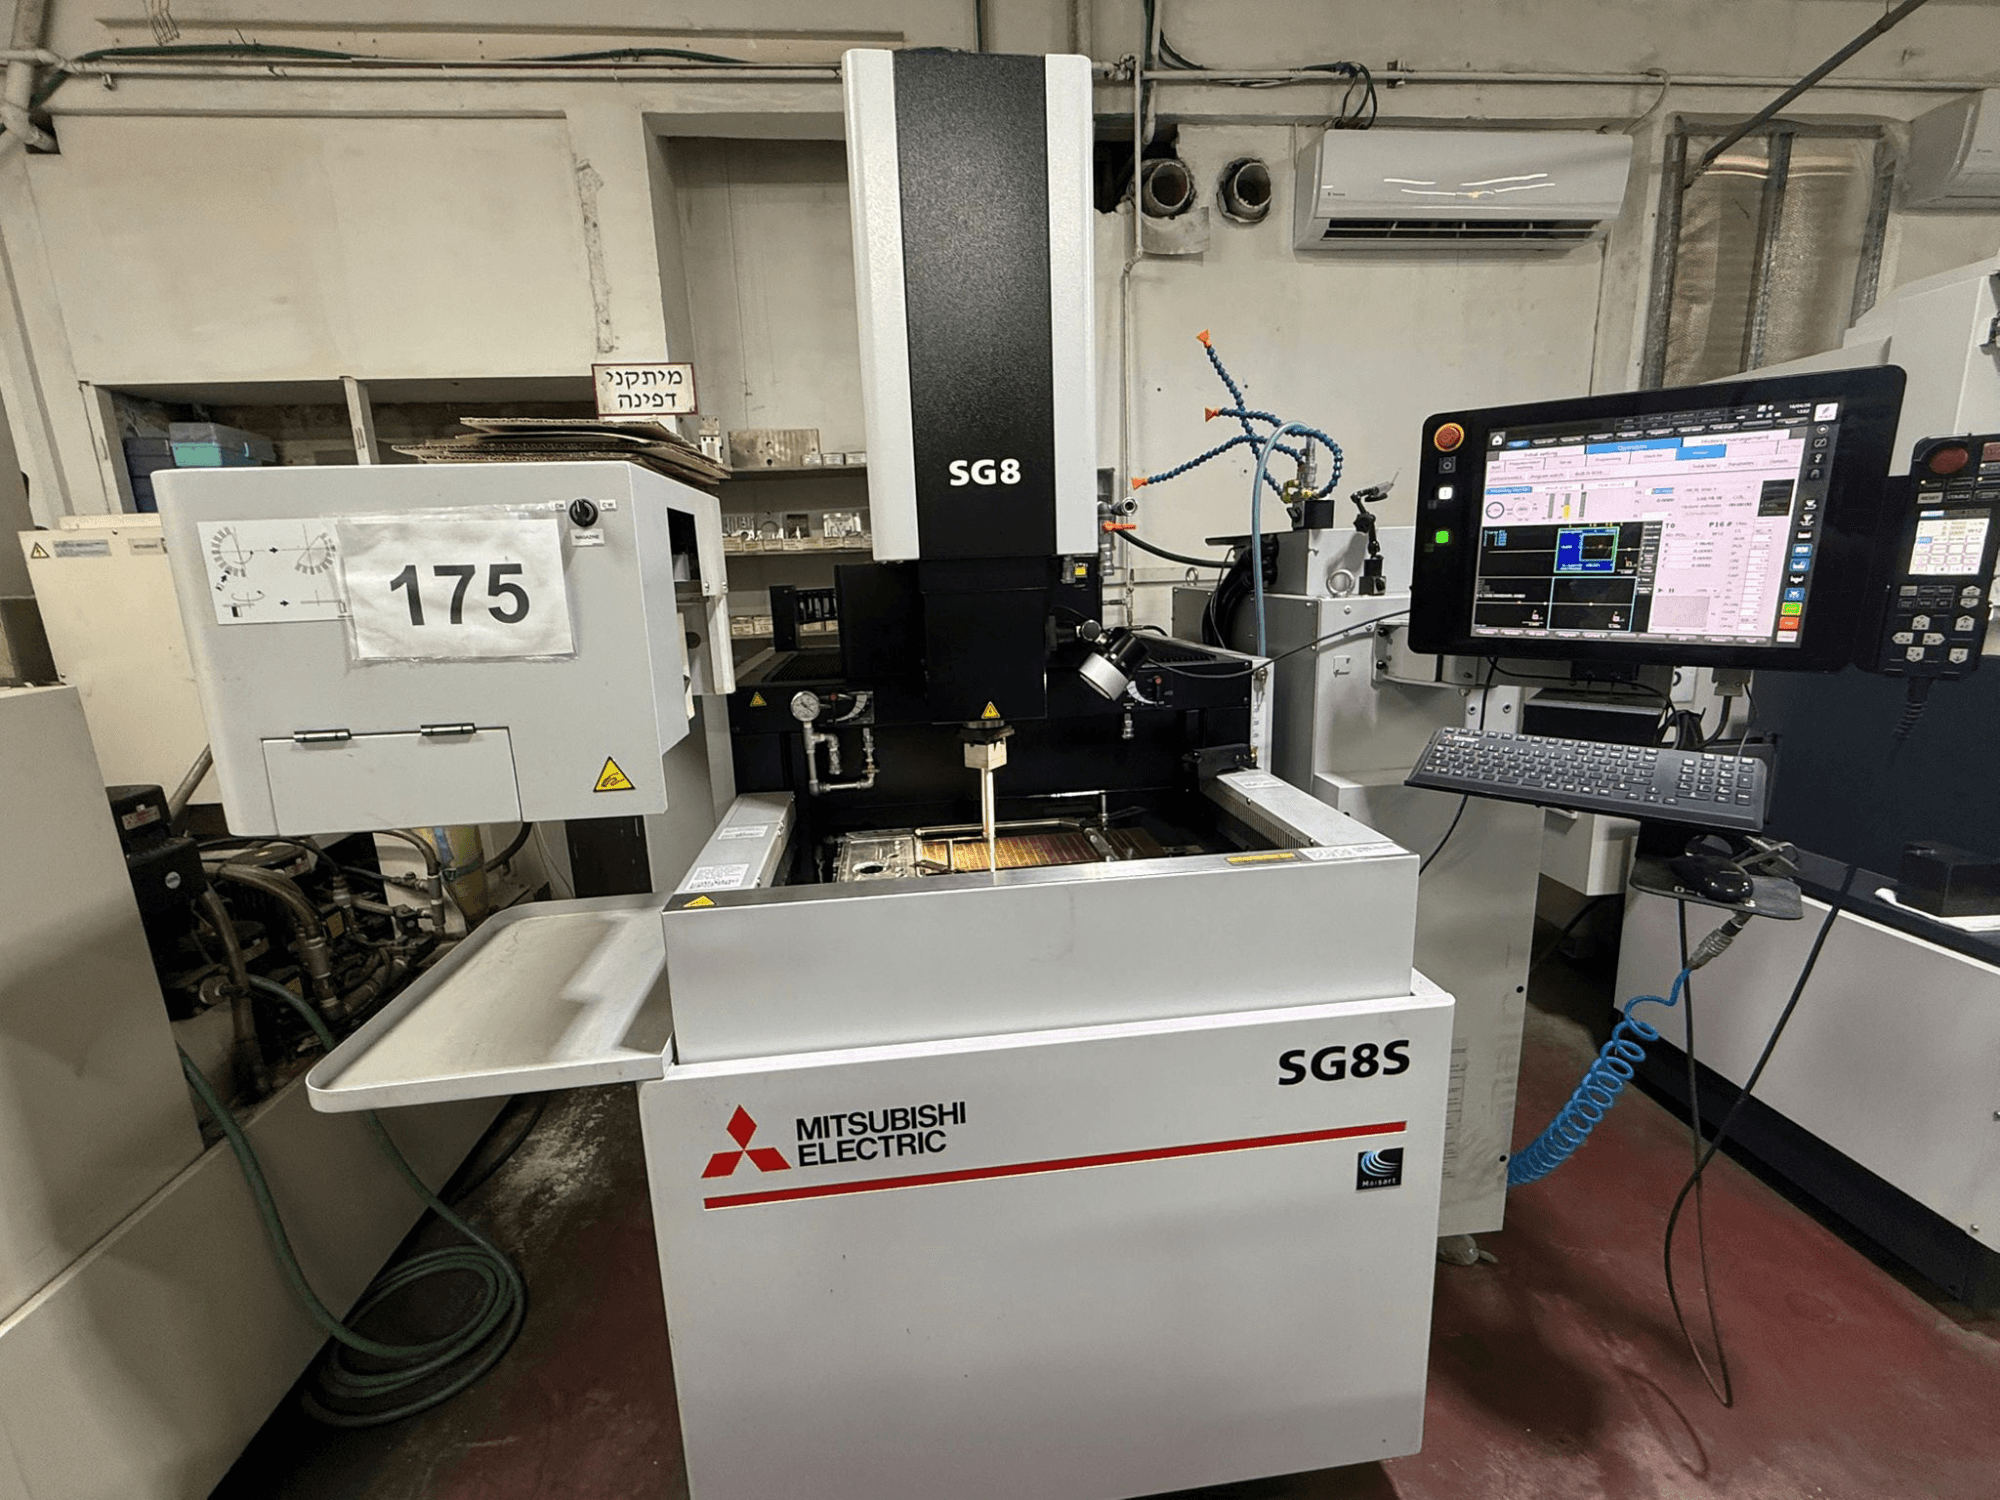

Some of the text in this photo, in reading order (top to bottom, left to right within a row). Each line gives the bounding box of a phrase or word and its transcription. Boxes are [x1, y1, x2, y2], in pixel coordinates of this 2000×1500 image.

[605, 370, 683, 390] מיתקני
[618, 393, 677, 408] דפינה
[948, 458, 1022, 487] SG8
[389, 563, 530, 626] 175
[1278, 1039, 1411, 1086] SG8S
[795, 1101, 967, 1142] MITSUBISHI
[798, 1129, 948, 1168] ELECTRIC
